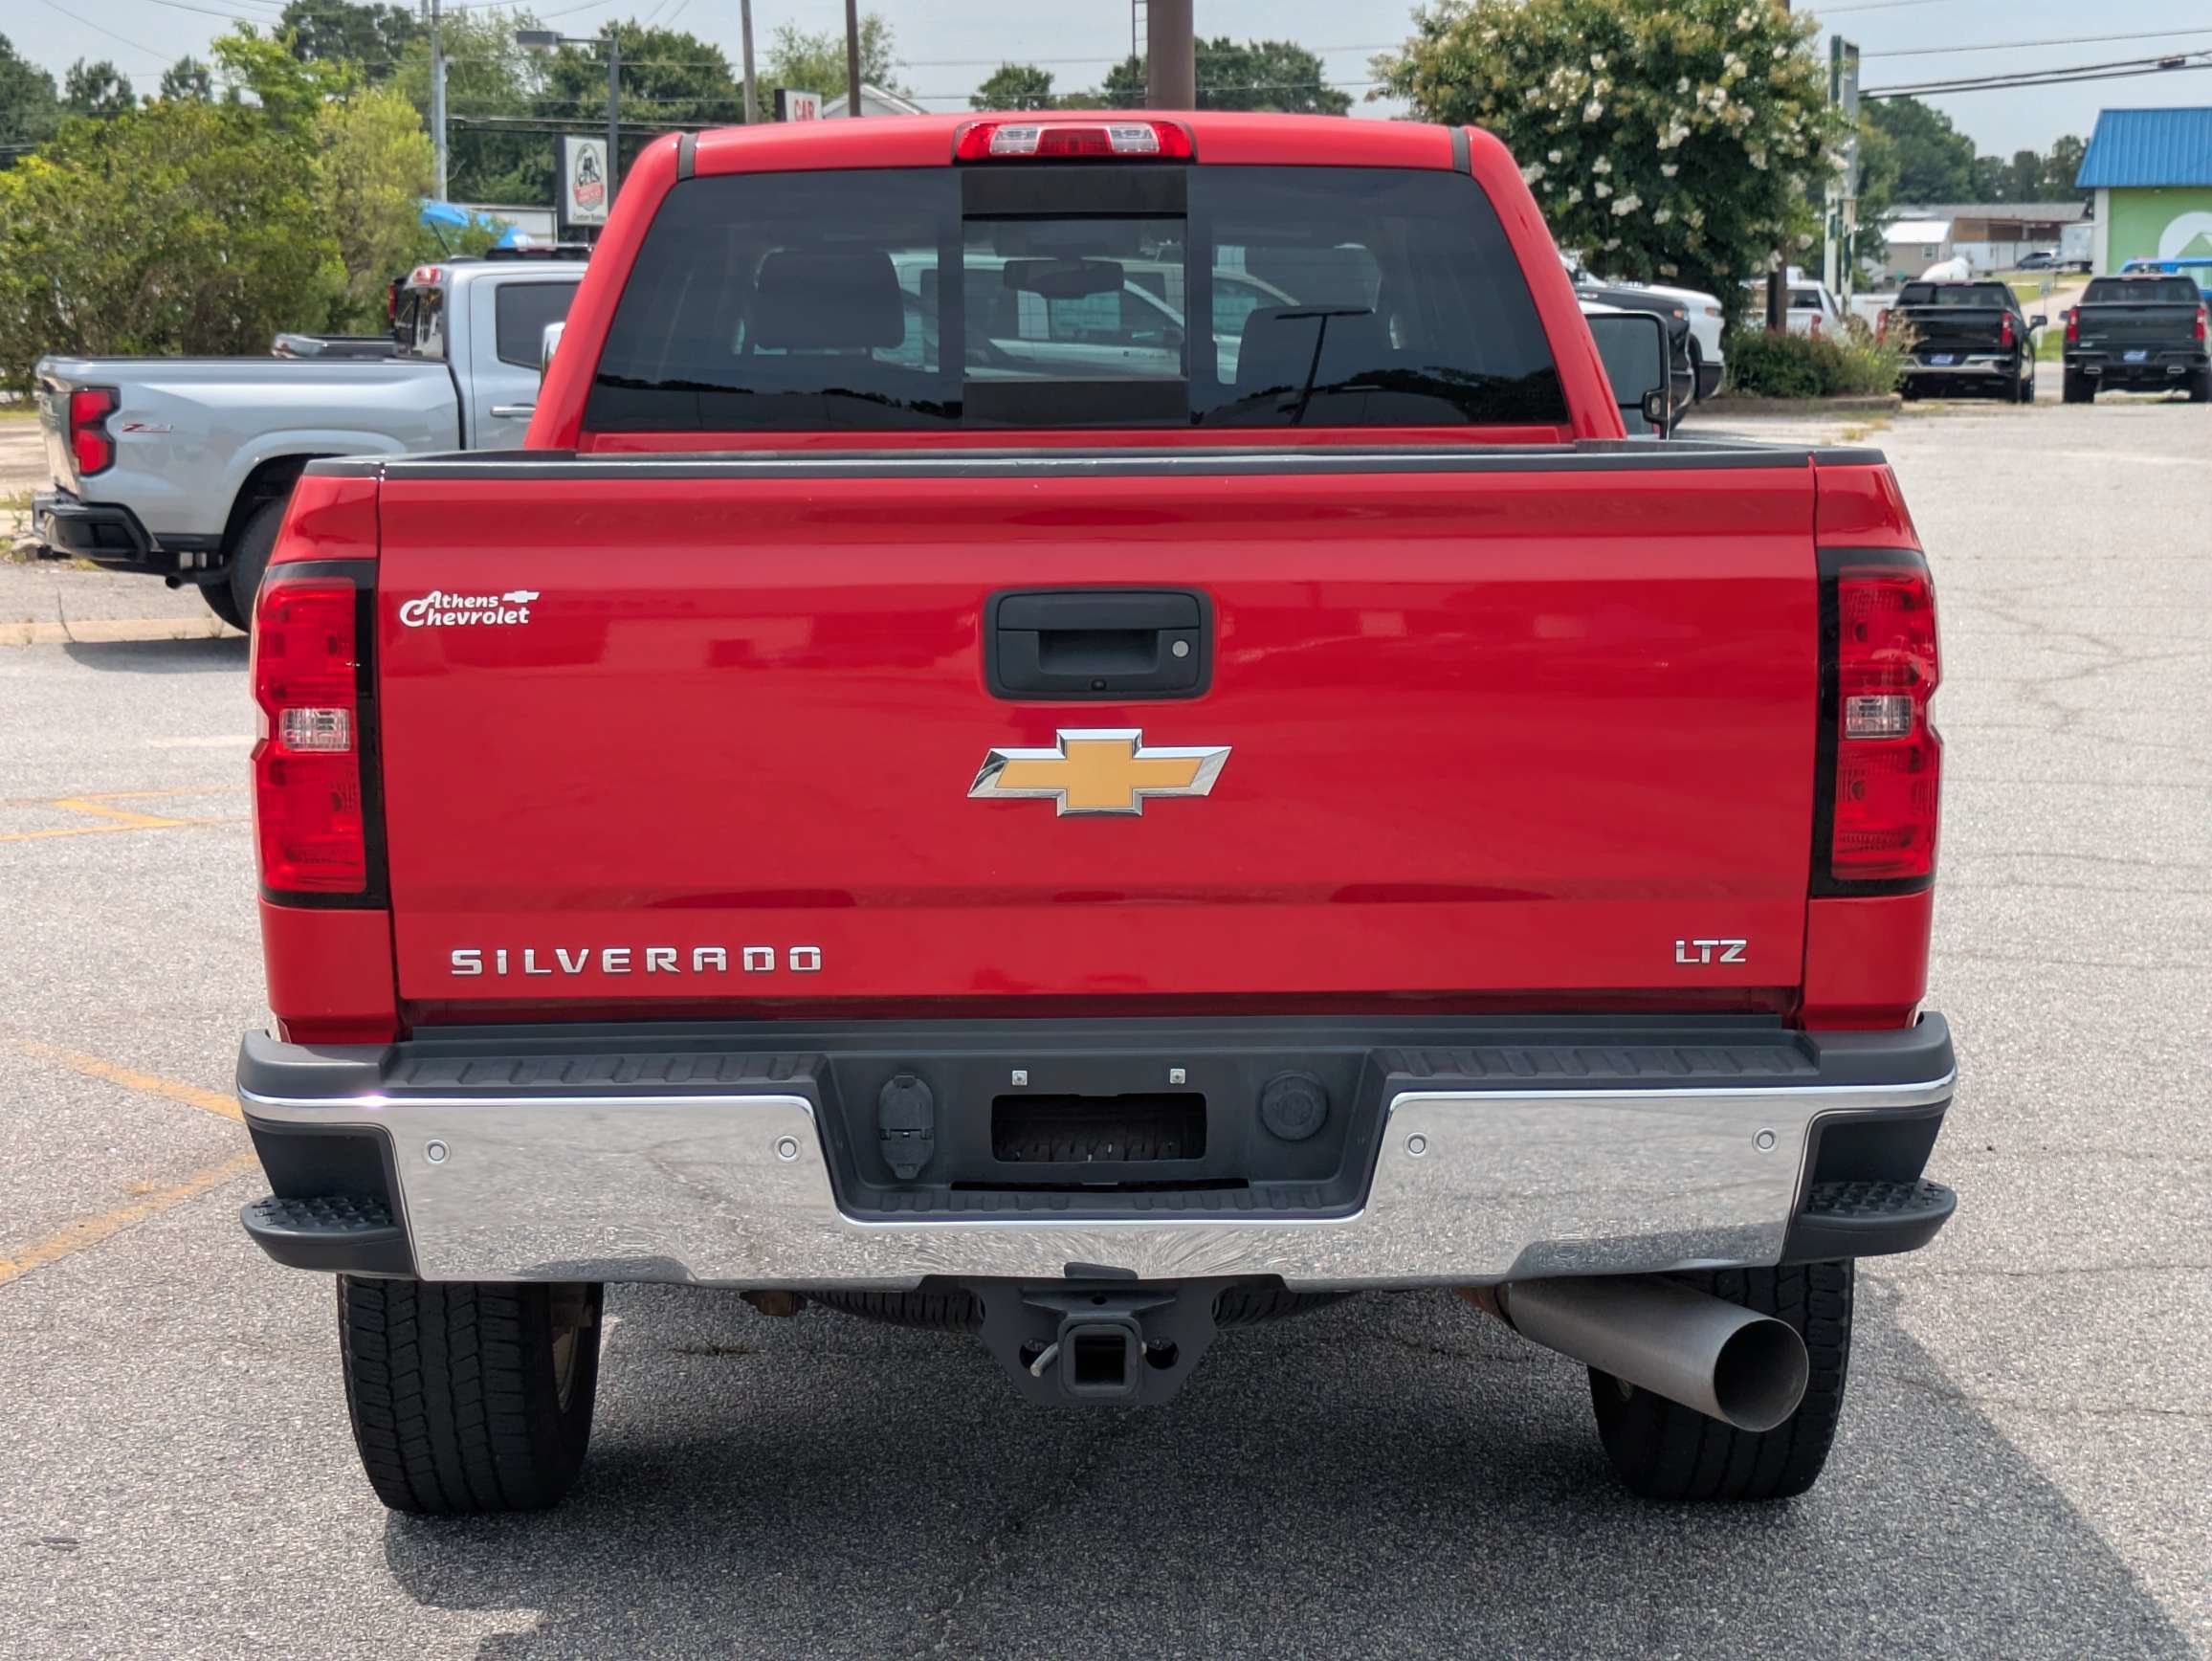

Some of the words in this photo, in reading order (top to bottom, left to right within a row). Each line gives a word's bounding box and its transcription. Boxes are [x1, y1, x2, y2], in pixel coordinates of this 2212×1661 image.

[423, 590, 499, 609] Athens
[399, 598, 530, 628] Chevrolet
[451, 946, 823, 975] SILVERADO
[1675, 940, 1747, 963] LTZ
